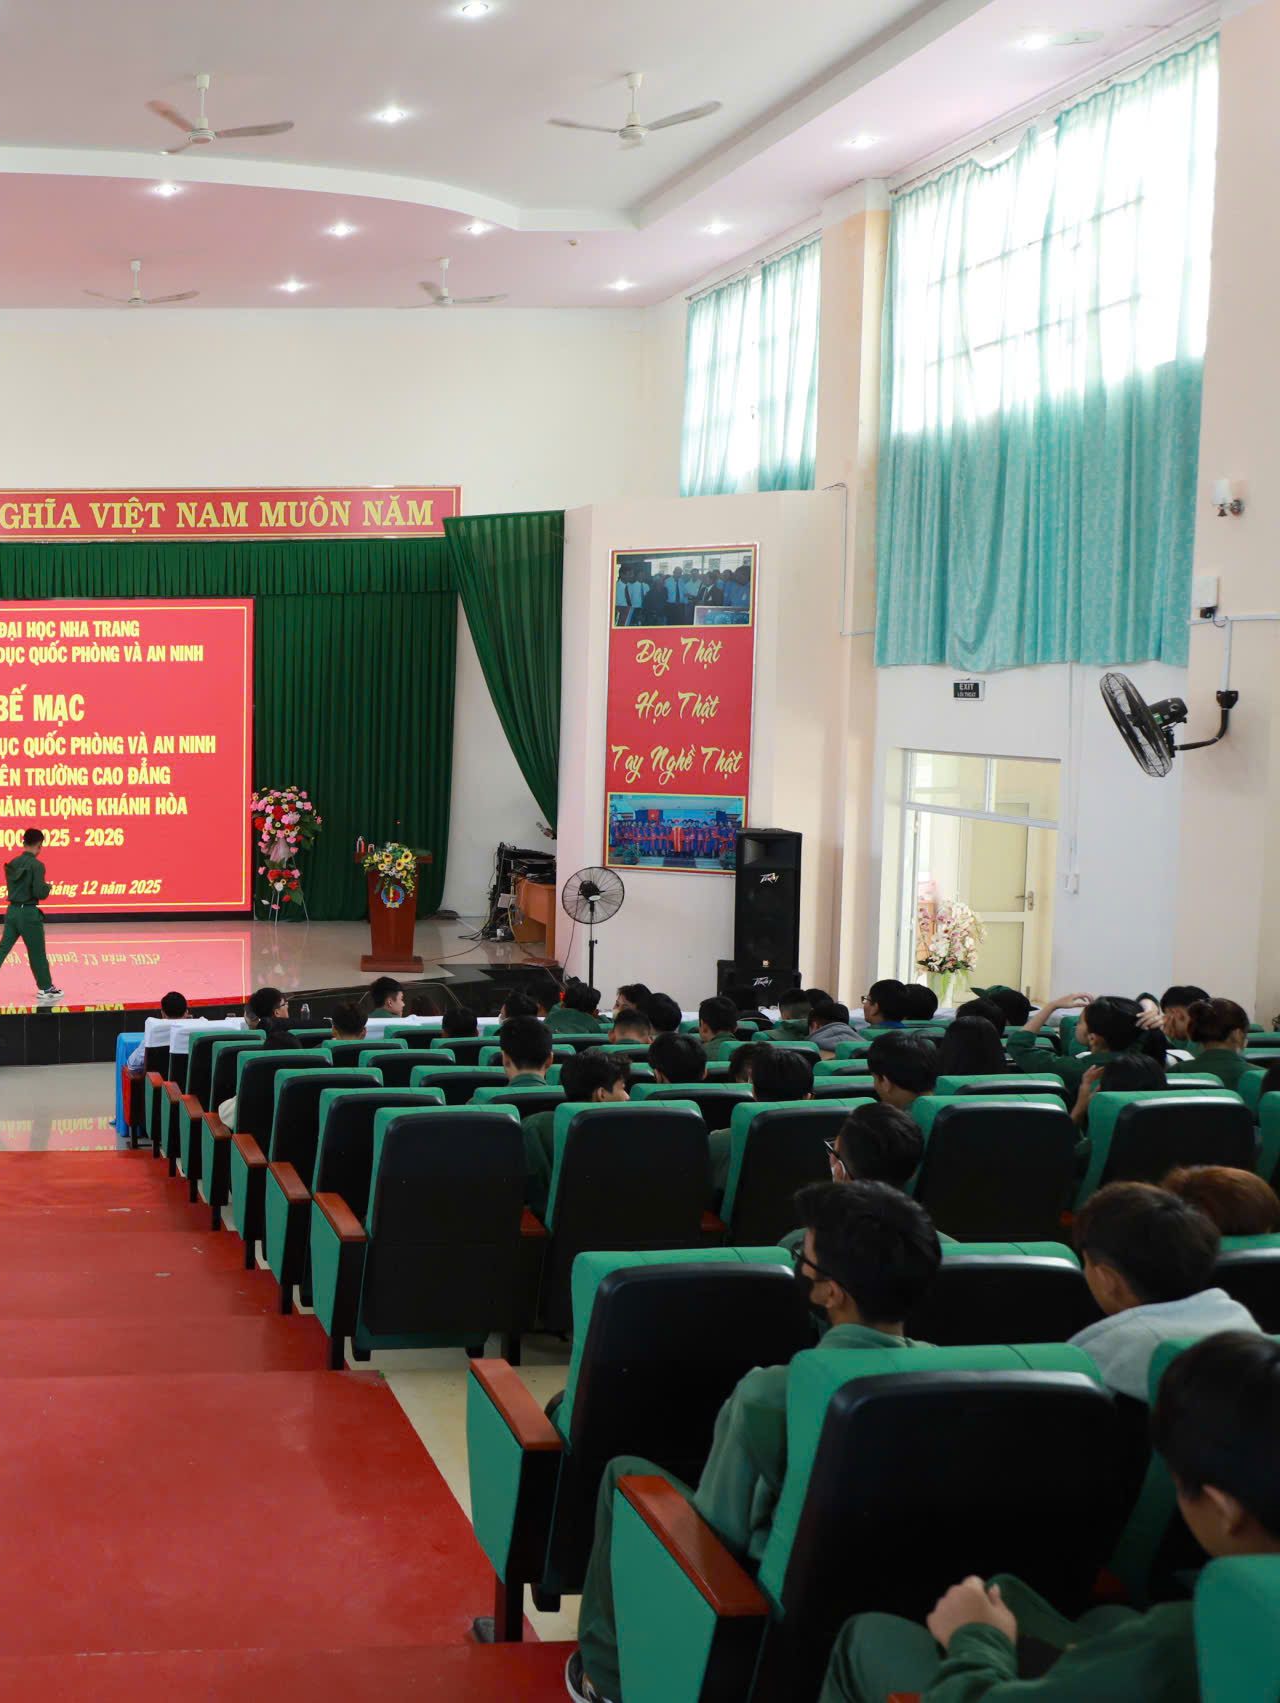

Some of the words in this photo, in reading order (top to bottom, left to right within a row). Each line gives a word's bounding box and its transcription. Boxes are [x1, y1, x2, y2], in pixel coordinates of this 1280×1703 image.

[87, 497, 168, 536] VIỆT
[176, 502, 248, 527] NAM
[260, 495, 352, 527] MUÔN
[363, 495, 433, 526] NĂM
[26, 621, 57, 641] HỌC
[60, 621, 89, 637] NHA
[93, 620, 139, 637] TRANG
[29, 638, 67, 666] QUỐC
[72, 642, 120, 662] PHÒNG
[124, 641, 142, 662] VÀ
[147, 646, 166, 662] AN
[170, 645, 203, 661] NINH
[636, 639, 673, 676] Dạy
[681, 637, 722, 669] Thật
[959, 683, 974, 691] EXIT
[34, 694, 84, 727] MẠC
[635, 690, 671, 723] Học
[678, 692, 719, 724] Thật
[24, 730, 66, 758] QUỐC
[71, 732, 124, 755] PHÒNG
[128, 732, 148, 754] VÀ
[153, 736, 174, 754] AN
[179, 736, 216, 753] NINH
[25, 763, 88, 786] TRƯỜNG
[92, 767, 123, 785] CAO
[128, 757, 170, 784] ĐẲNG
[612, 745, 644, 783] Tay
[651, 744, 695, 785] Nghề
[701, 746, 743, 779] Thật
[41, 795, 92, 819] LƯỢNG
[97, 793, 150, 815] KHÁNH
[156, 792, 188, 815] HÒA
[41, 829, 70, 846] 025
[85, 828, 124, 846] 2026
[81, 881, 98, 894] 12
[100, 882, 126, 894] năm
[129, 880, 162, 894] 2025
